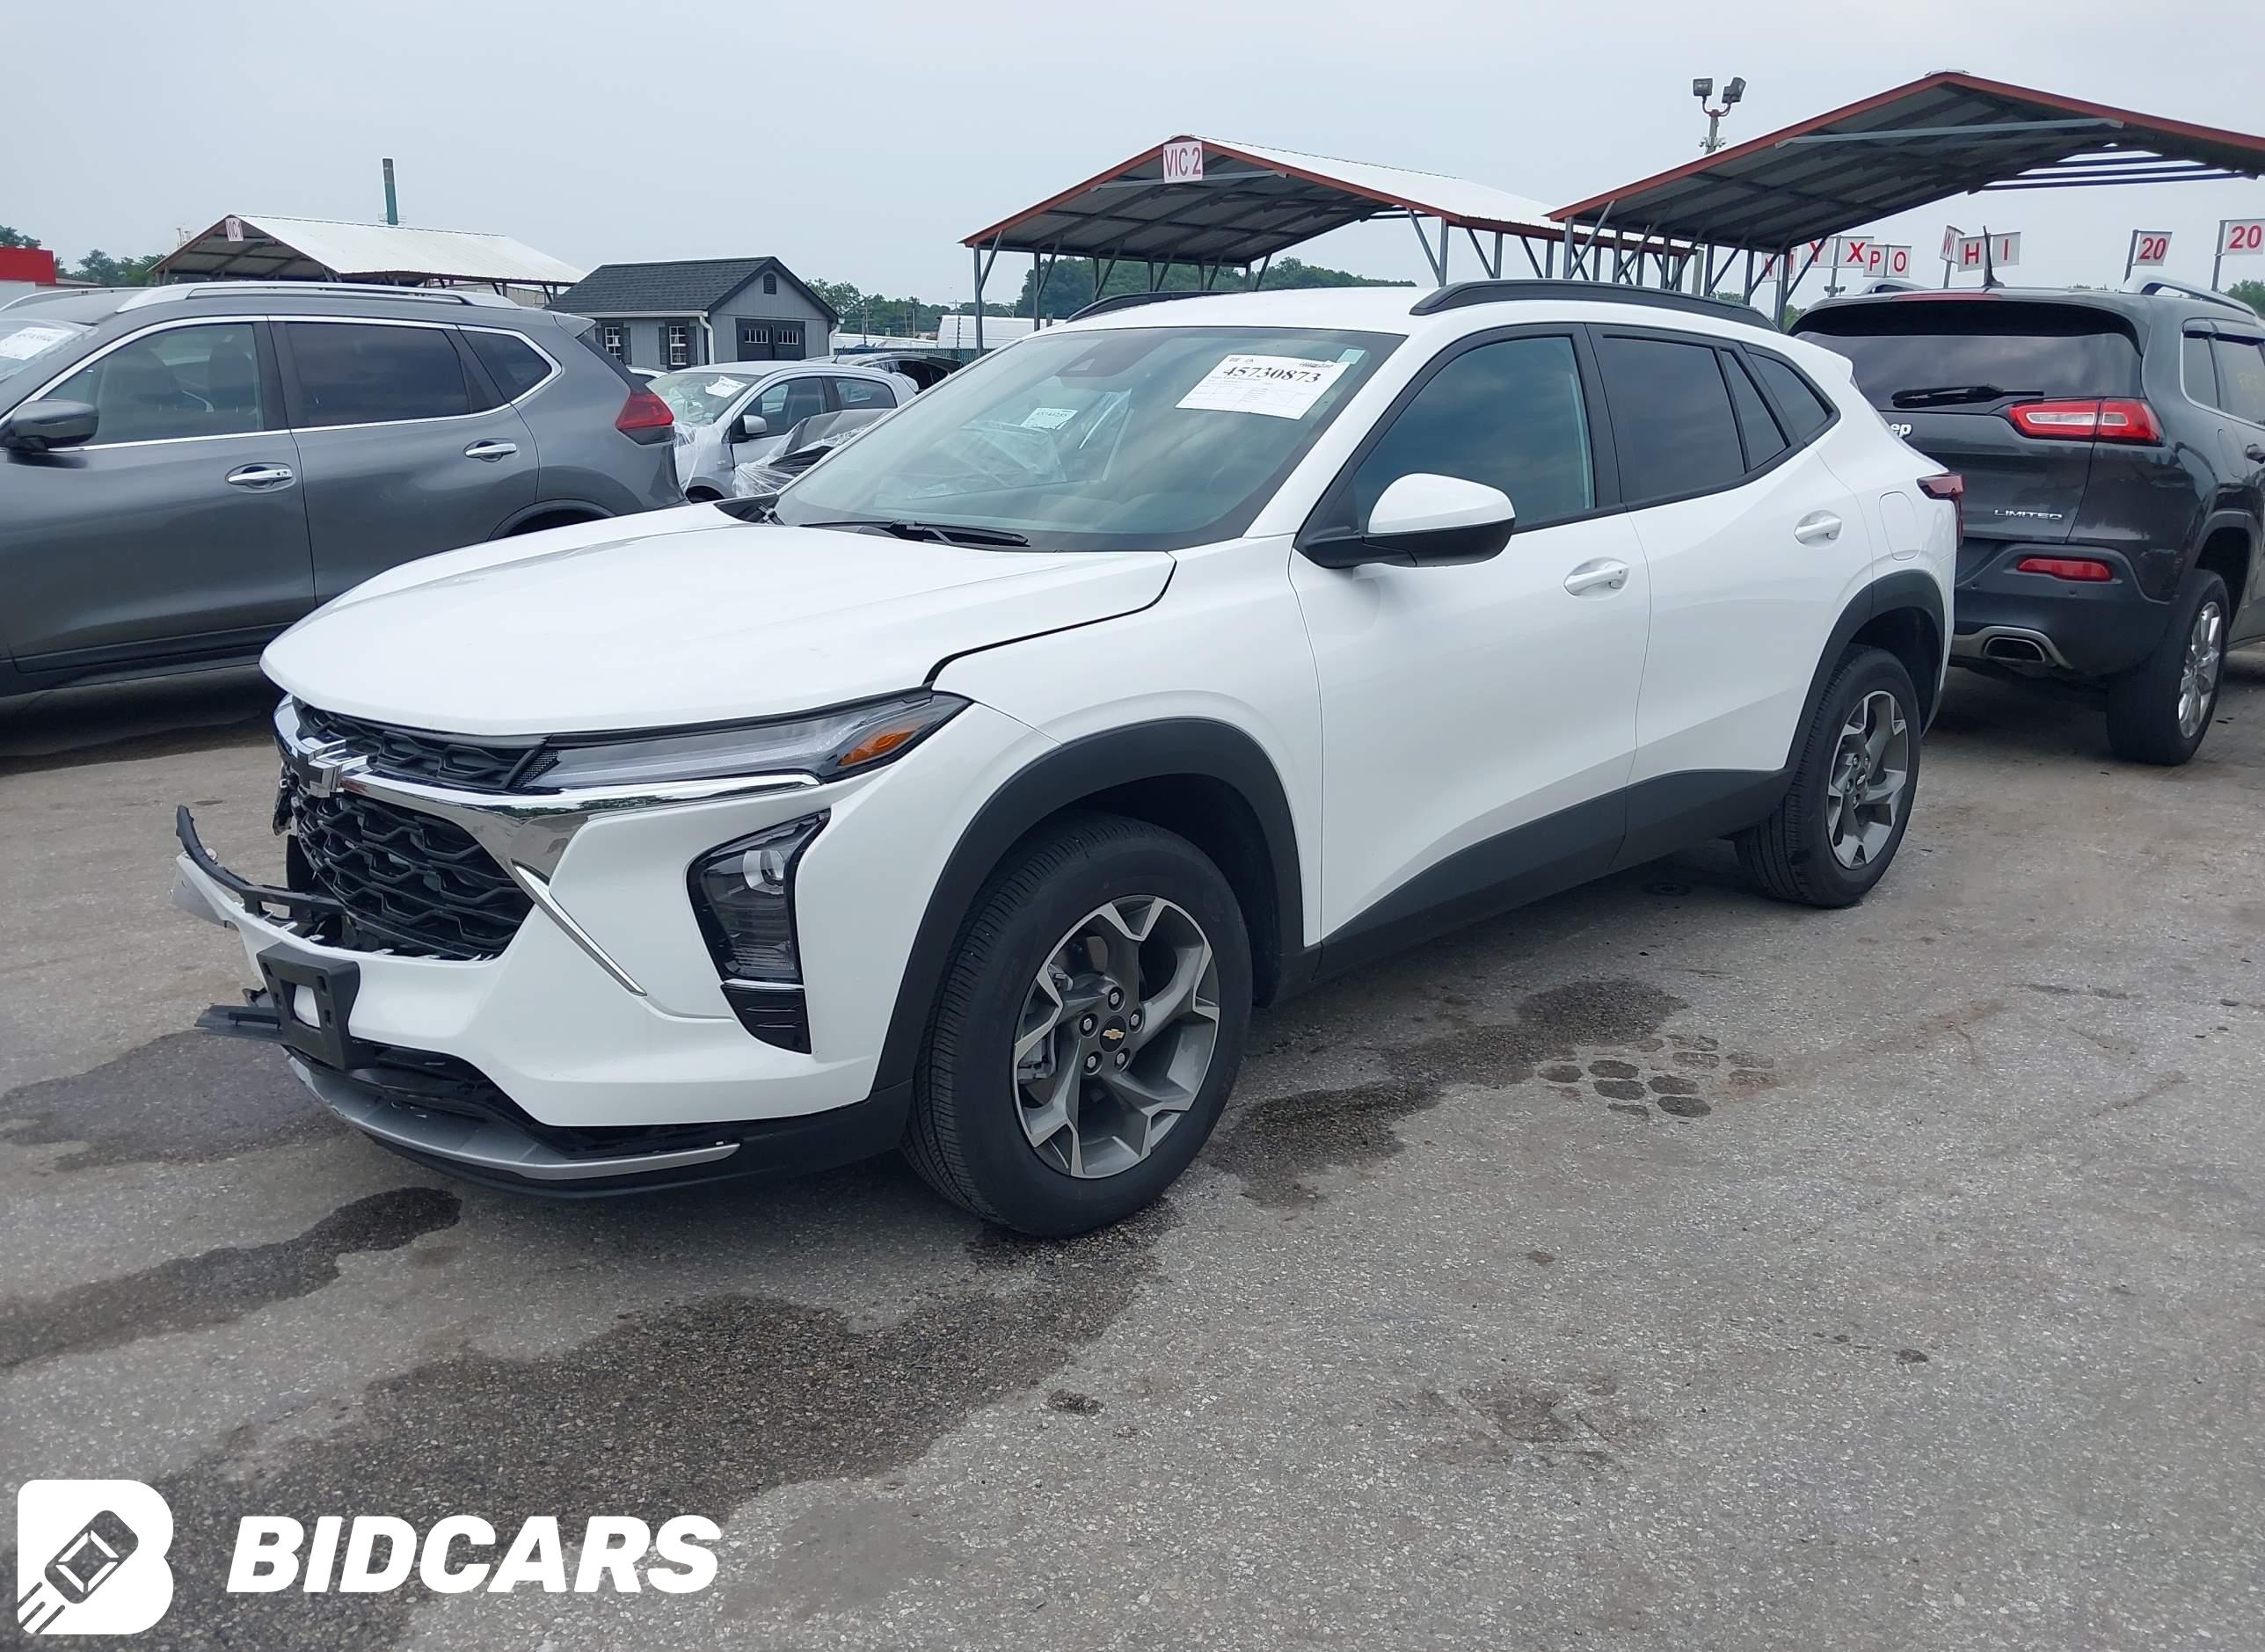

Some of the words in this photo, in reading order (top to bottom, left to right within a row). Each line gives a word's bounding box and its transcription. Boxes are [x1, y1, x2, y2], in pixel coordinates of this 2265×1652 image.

[1164, 147, 1188, 177] VIC
[1192, 146, 1201, 175] 2
[2229, 225, 2262, 249] 20
[1846, 242, 1866, 263] X
[1965, 242, 1980, 265] H
[2138, 237, 2167, 260] 20
[1869, 251, 1881, 272] P
[1223, 366, 1322, 383] 45730873
[1993, 509, 2063, 520] LIMITED
